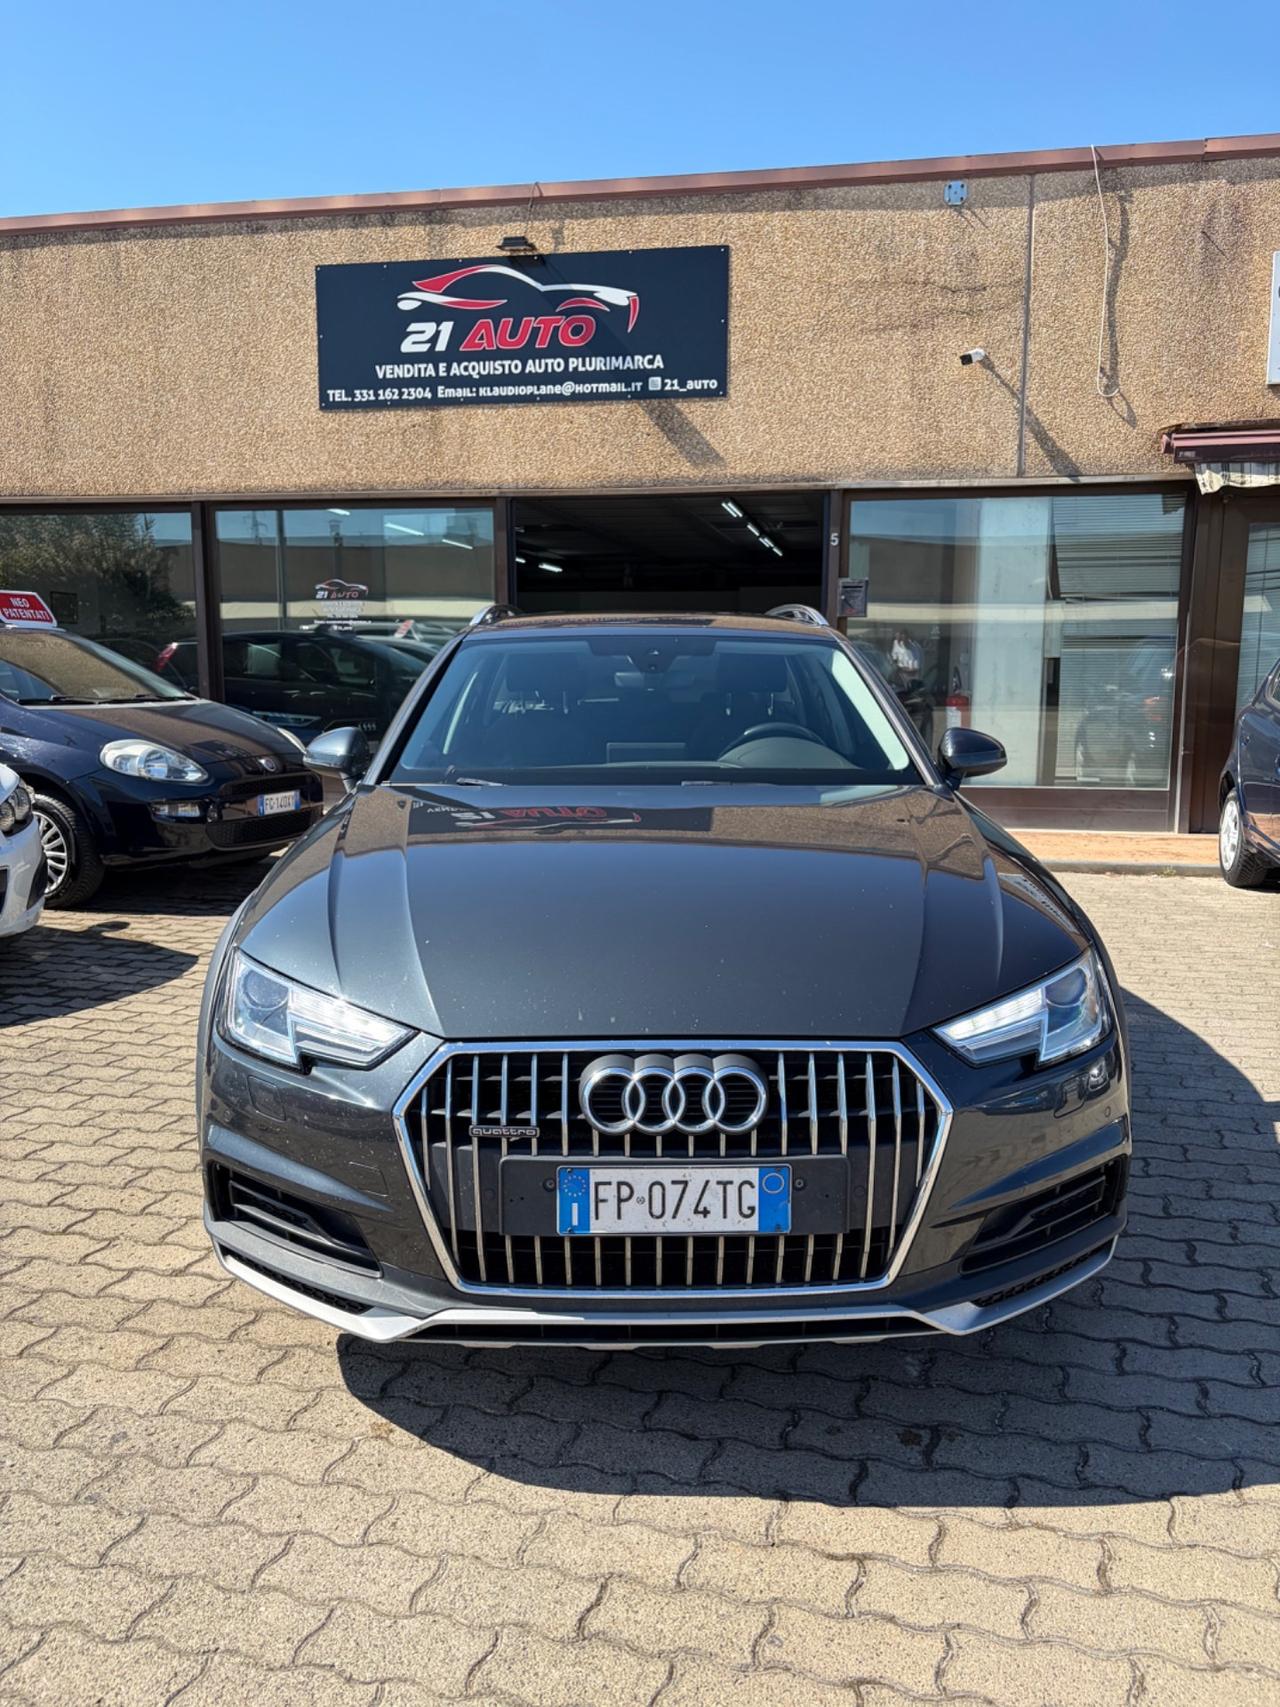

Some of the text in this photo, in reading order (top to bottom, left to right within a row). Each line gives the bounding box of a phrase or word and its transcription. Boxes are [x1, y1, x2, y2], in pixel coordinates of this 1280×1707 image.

[400, 314, 597, 353] 21 AUTO
[375, 354, 664, 379] VENDITA E ACQUISTO AUTO PLURIMARCA
[327, 389, 352, 402] TEL.
[354, 389, 376, 401] 331
[378, 388, 399, 400] 162
[401, 386, 432, 400] 2304
[830, 532, 839, 546] 5
[9, 597, 30, 608] NEO
[472, 1128, 537, 1136] quattro
